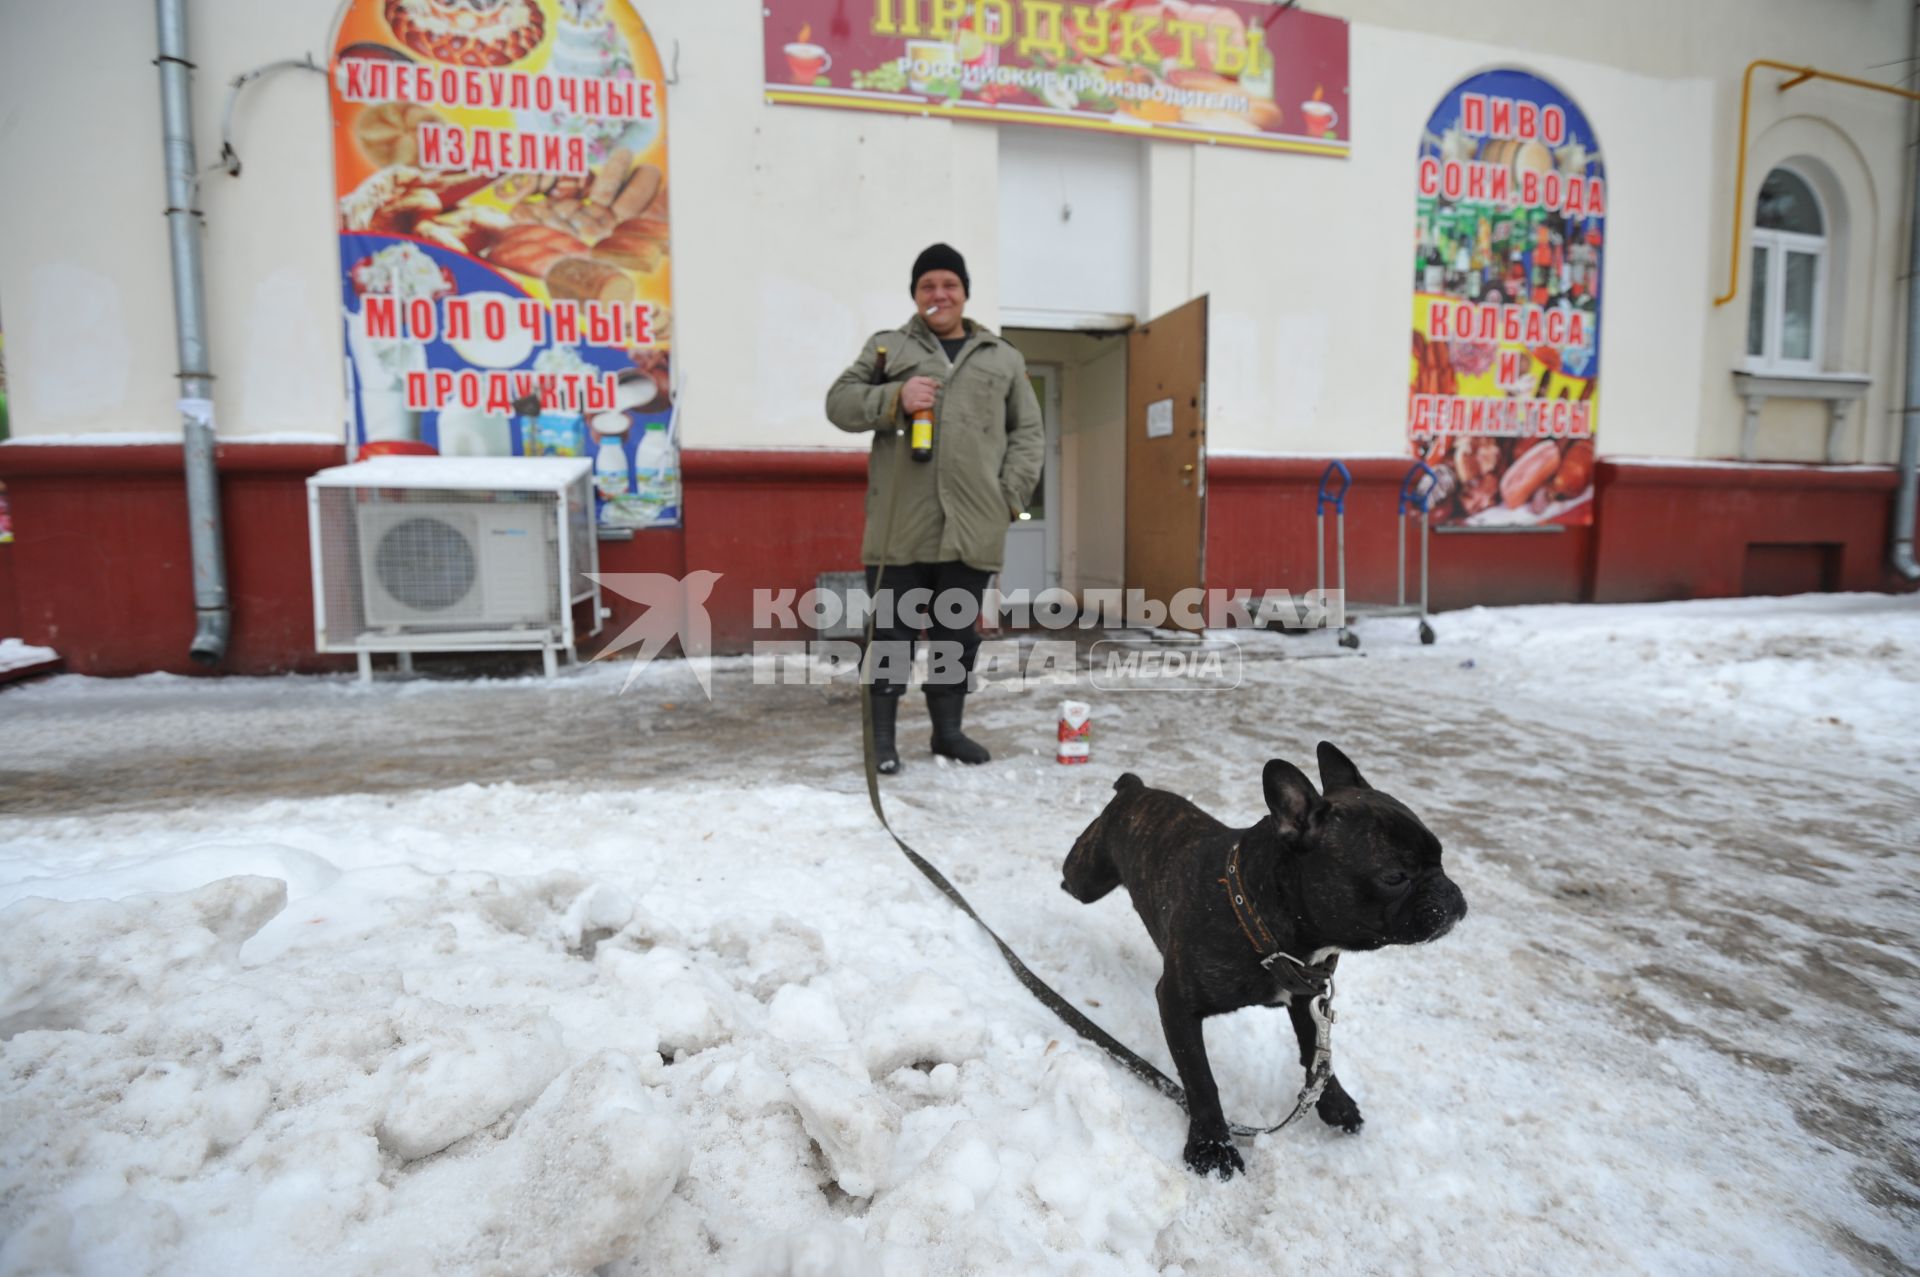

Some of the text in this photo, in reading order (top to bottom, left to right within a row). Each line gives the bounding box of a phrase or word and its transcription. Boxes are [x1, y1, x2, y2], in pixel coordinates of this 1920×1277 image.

[872, 0, 1265, 76] ПРОДУКТЫ
[346, 61, 655, 119] ХЛЕБОБУЛОЧНЫЕ
[1463, 96, 1562, 143] ПИВО
[421, 126, 585, 173] ИЗДЕЛИЯ
[364, 297, 654, 344] МОЛОЧНЫЕ
[1430, 303, 1584, 345] КОЛБАСА
[1500, 352, 1516, 385] И
[407, 371, 618, 414] ПРОДУКТЫ
[1412, 396, 1590, 435] ДЕЛИКАТЕСЫ
